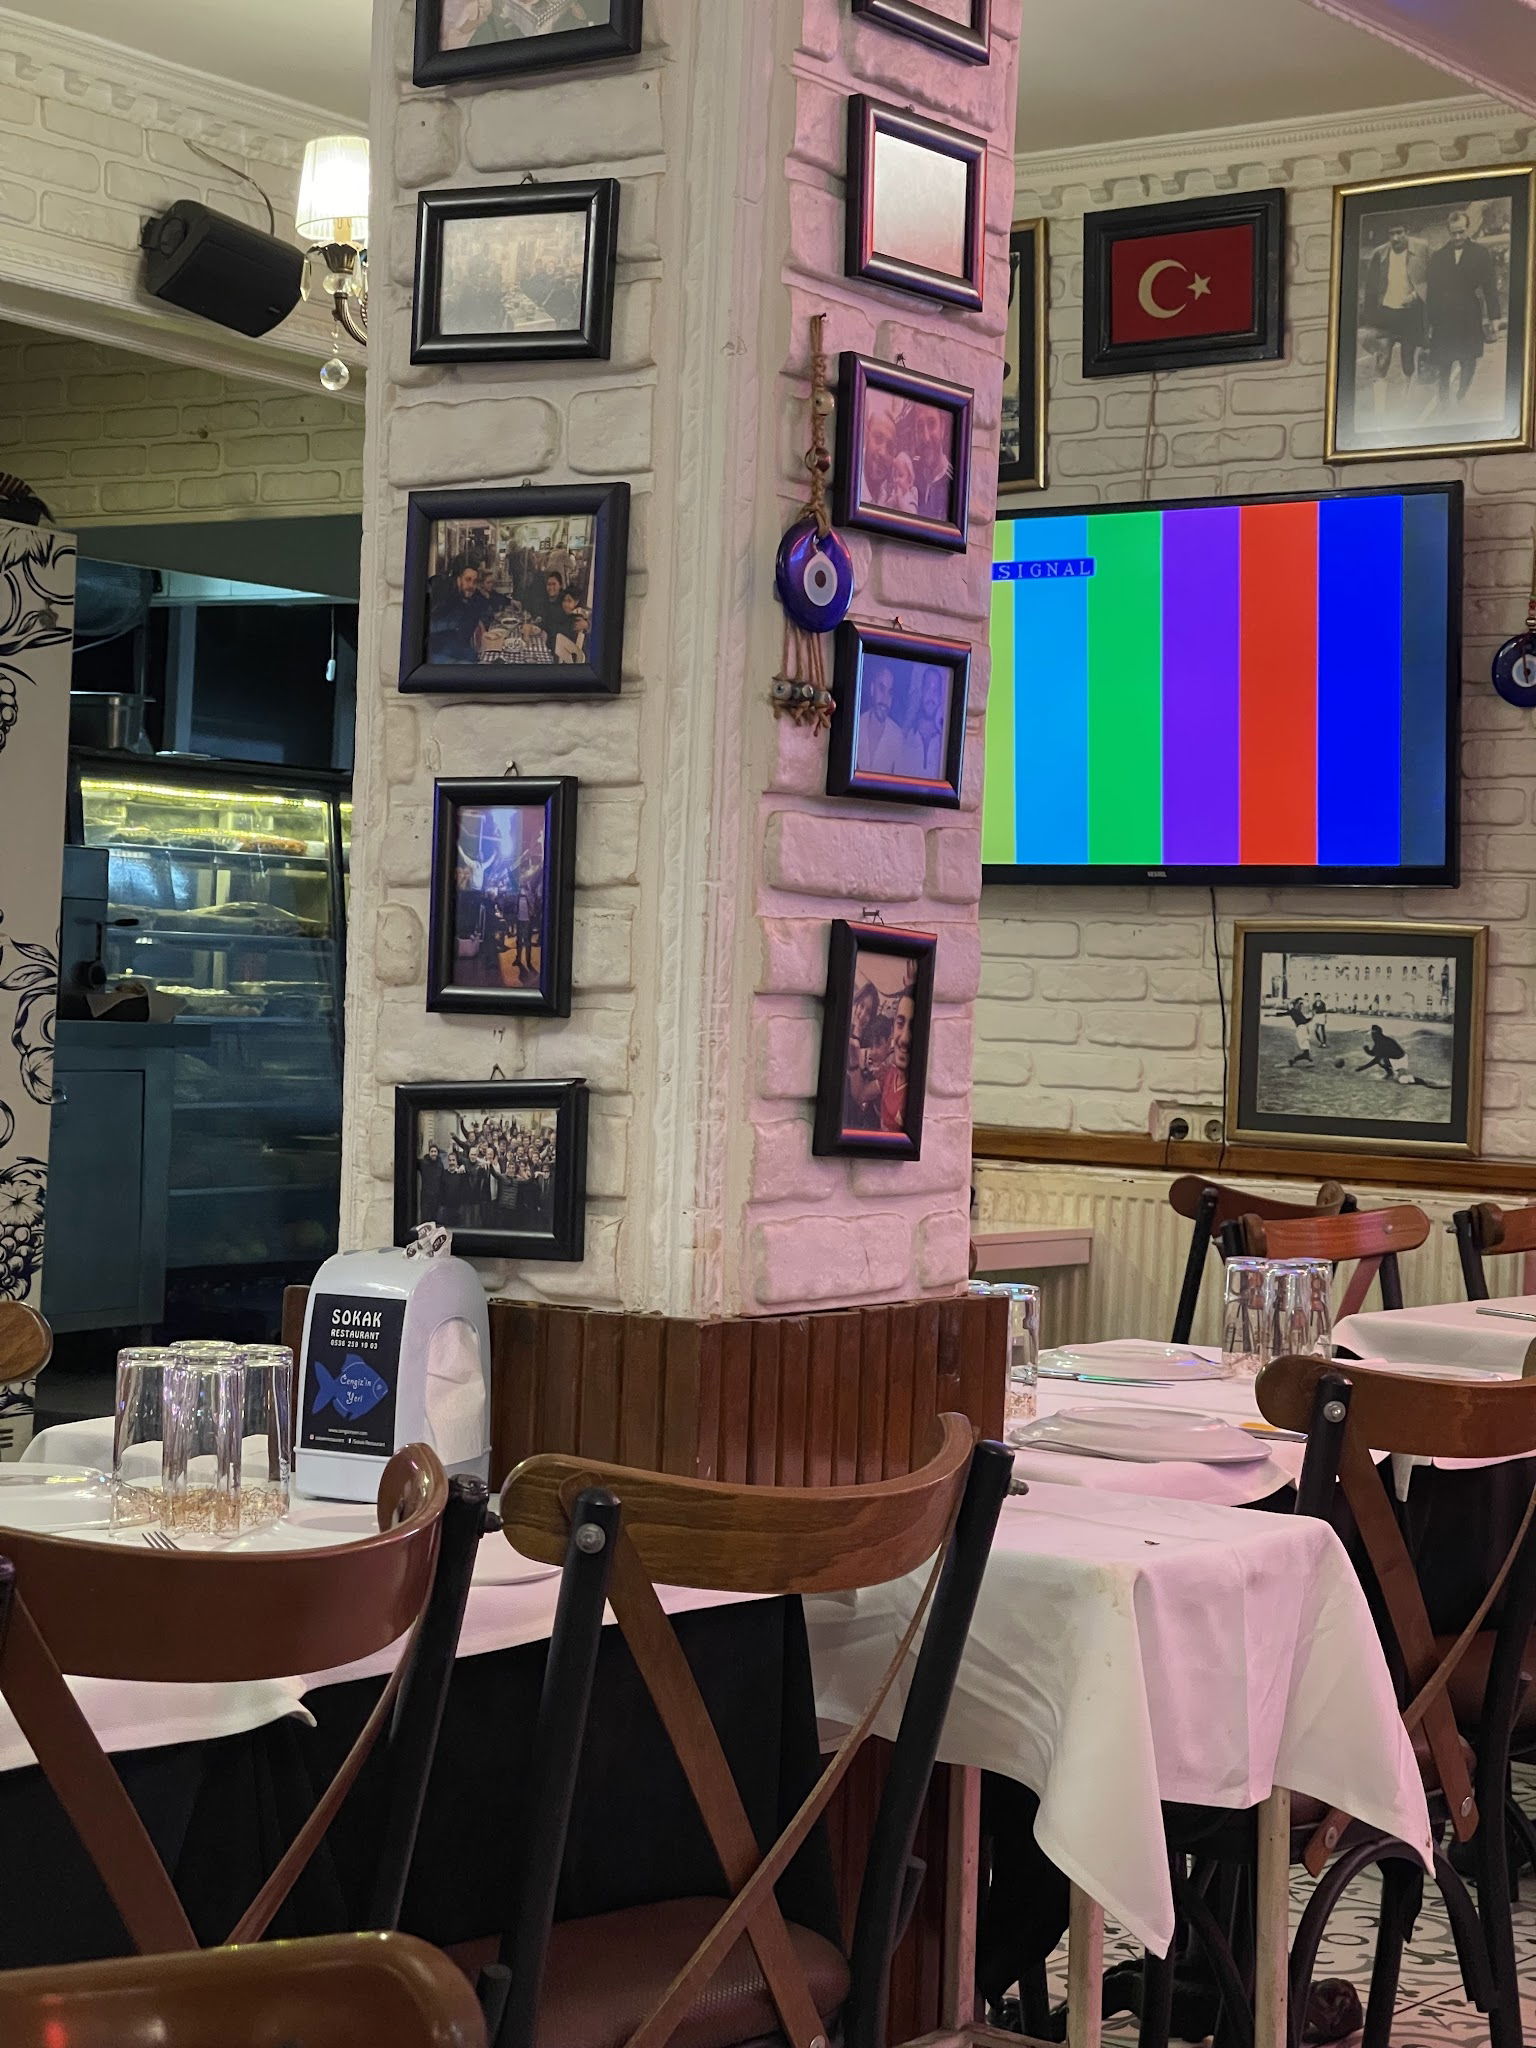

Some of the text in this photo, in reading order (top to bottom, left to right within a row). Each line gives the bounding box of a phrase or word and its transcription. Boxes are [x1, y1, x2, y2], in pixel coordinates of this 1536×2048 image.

[998, 560, 1091, 579] SIGNAL
[332, 1309, 382, 1327] SOKAK
[331, 1329, 379, 1340] RESTAURANT
